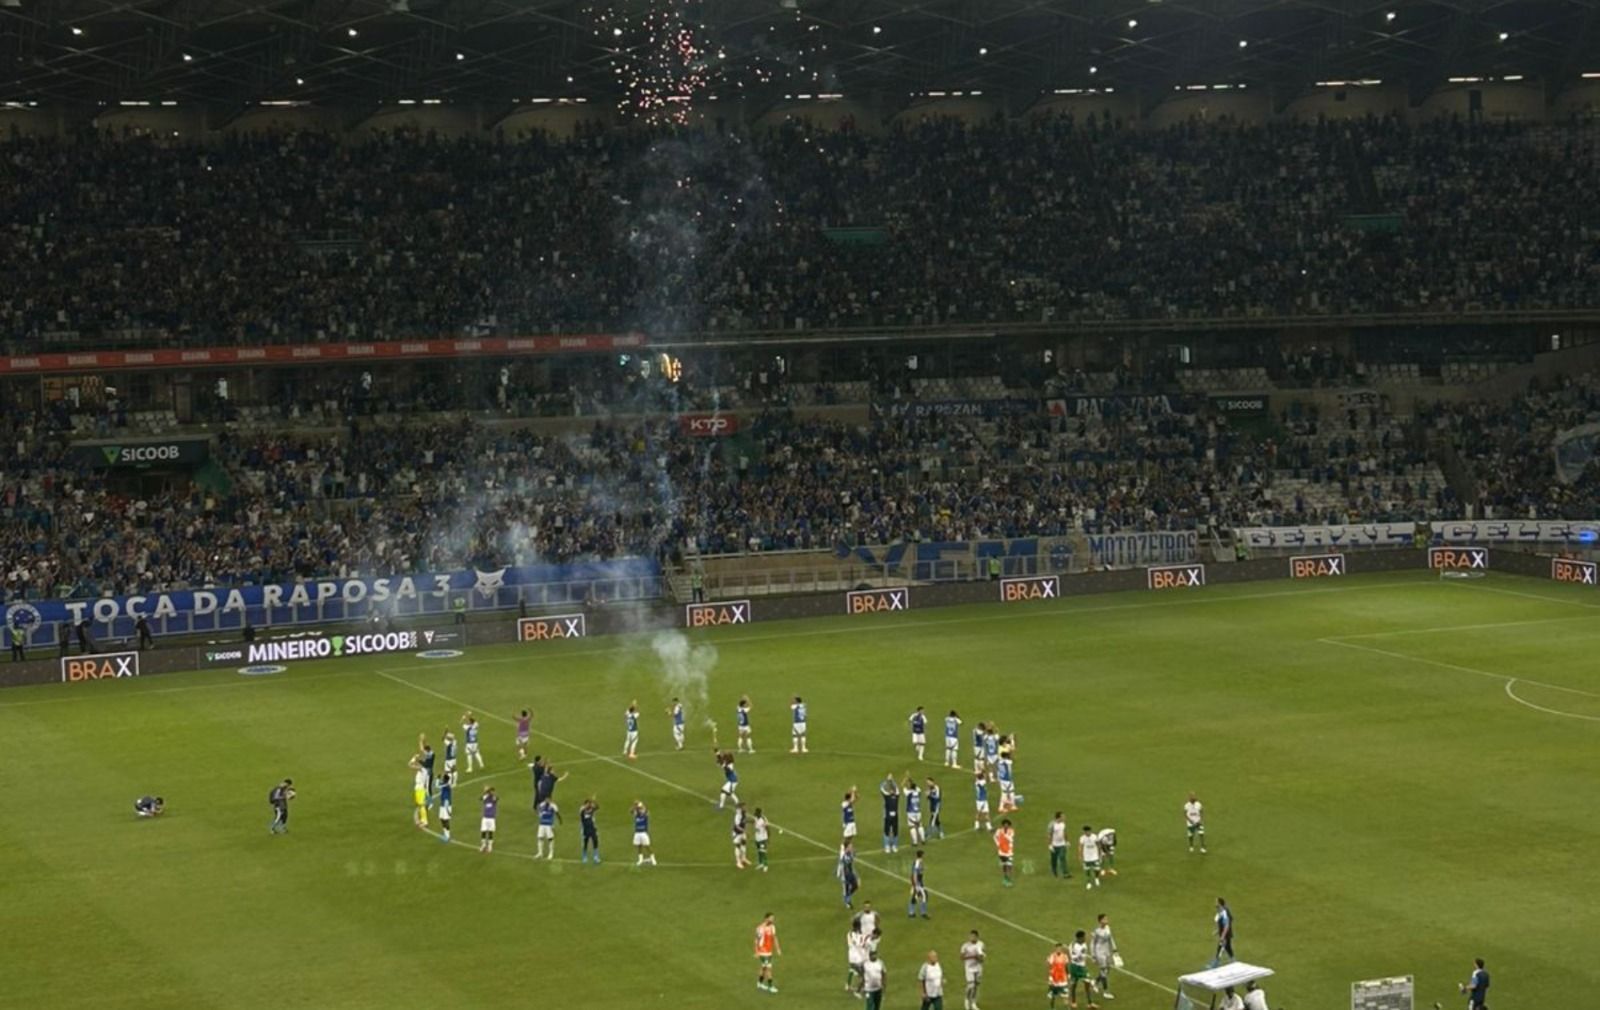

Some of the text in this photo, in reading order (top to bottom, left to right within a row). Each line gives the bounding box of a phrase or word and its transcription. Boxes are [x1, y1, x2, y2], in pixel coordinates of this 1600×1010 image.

[1227, 400, 1264, 411] SICOOB
[121, 446, 180, 461] SICOOB
[1089, 532, 1196, 565] MOTOZEIROS
[1433, 549, 1484, 568] BRAX
[1296, 558, 1340, 577] BRAX
[1556, 563, 1594, 584] BRAX
[1153, 569, 1200, 588] BRAX
[64, 594, 177, 625] TOCA
[193, 588, 246, 616] DA
[263, 577, 417, 608] RAPOSA
[432, 575, 451, 597] 3
[1005, 580, 1054, 600] BRAX
[853, 592, 903, 613] BRAX
[692, 605, 745, 627] BRAX
[524, 619, 579, 640] BRAX
[249, 638, 330, 663] MINEIRO
[346, 631, 410, 655] SICOOB
[69, 656, 132, 681] BRAX
